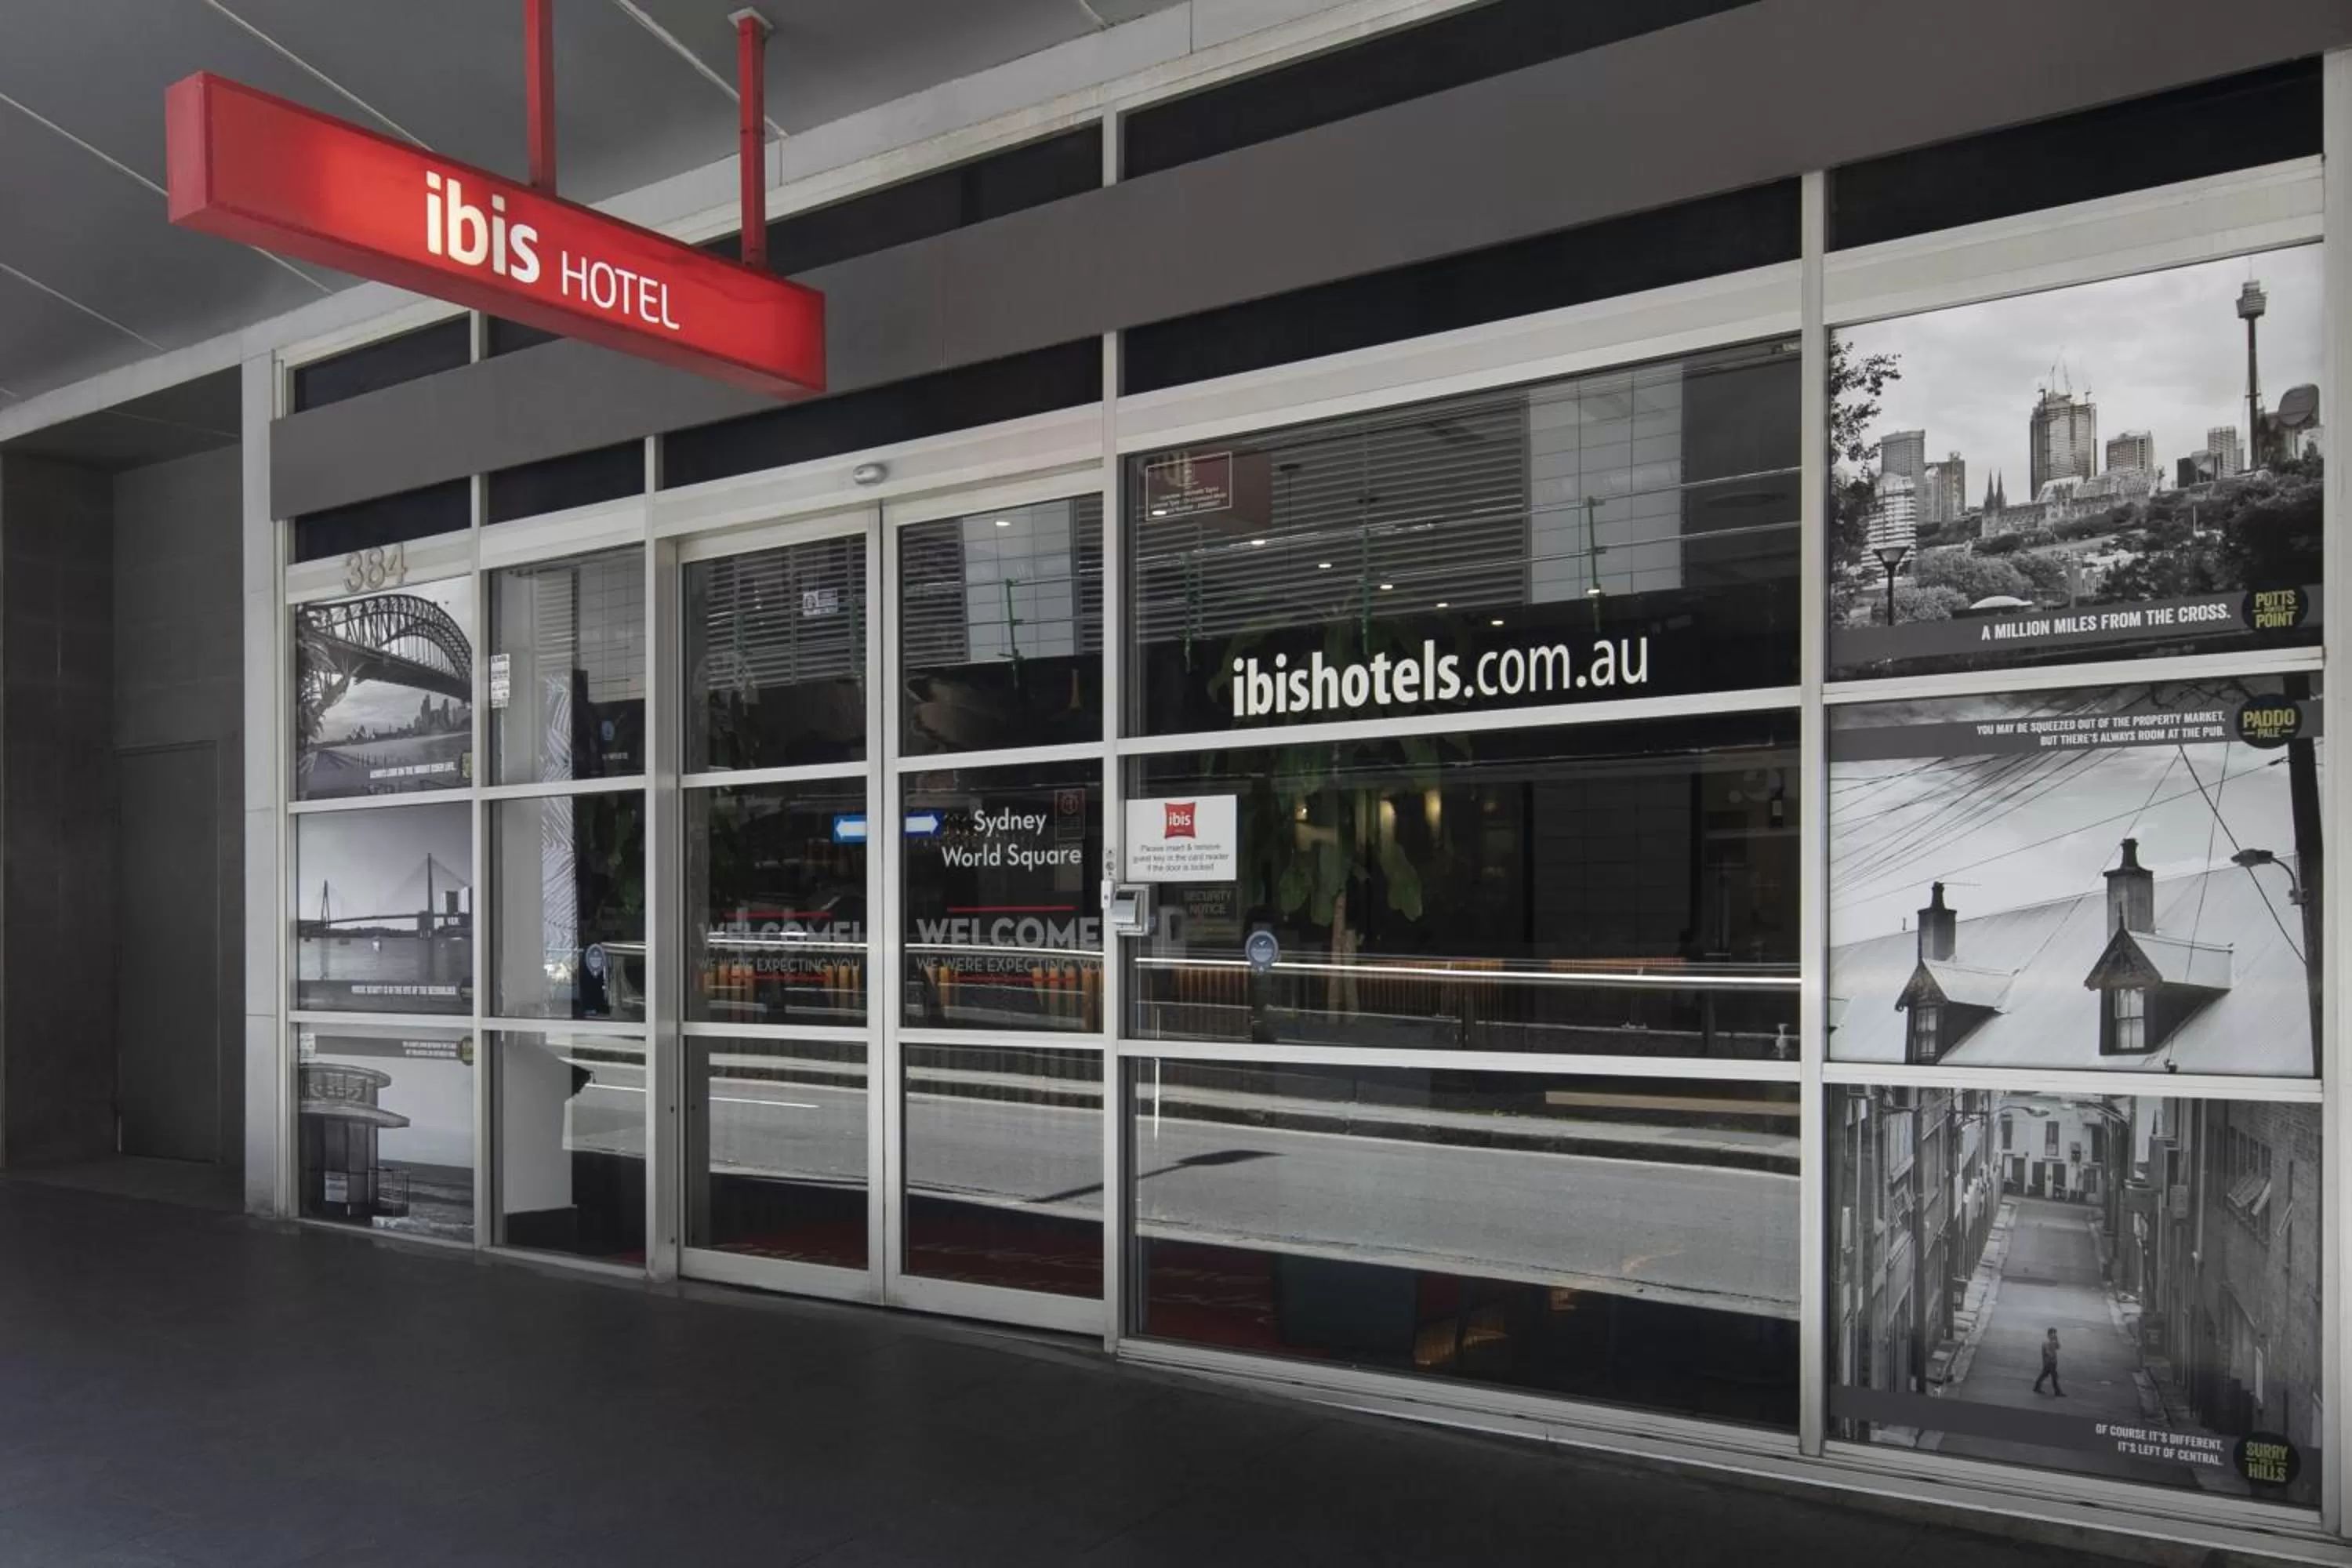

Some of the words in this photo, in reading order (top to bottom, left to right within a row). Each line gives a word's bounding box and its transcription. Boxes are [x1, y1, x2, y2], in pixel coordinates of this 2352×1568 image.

[426, 170, 540, 283] ibis
[561, 251, 680, 329] HOTEL
[343, 542, 408, 592] 384
[2256, 590, 2296, 608] POTTS
[1981, 626, 1991, 641] A
[1994, 619, 2050, 640] MILLION
[2053, 617, 2096, 634] MILES
[2101, 612, 2141, 629] FROM
[2146, 608, 2172, 626] THE
[2178, 604, 2231, 622] CROSS.
[2256, 611, 2296, 629] POINT
[1233, 637, 1648, 717] ibishotels.com.au
[1976, 724, 1994, 735] YOU
[1996, 723, 2015, 734] MAY
[2016, 723, 2028, 733] BE
[2031, 720, 2076, 733] SQUEEZED
[2078, 718, 2096, 729] OUT
[2098, 717, 2109, 728] OF
[2114, 717, 2130, 728] THE
[2132, 713, 2182, 726] PROPERTY
[2183, 710, 2226, 724] MARKET.
[2243, 708, 2296, 728] PADDO
[2040, 735, 2058, 746] BUT
[2060, 733, 2099, 746] THERE'S
[2100, 731, 2136, 742] ALWAYS
[2138, 728, 2165, 740] ROOM
[2167, 728, 2180, 739] AT
[2182, 727, 2201, 738] THE
[2202, 726, 2226, 737] PUB.
[2257, 727, 2281, 738] PALE
[973, 807, 1047, 837] Sydney
[1169, 812, 1191, 826] ibis
[942, 843, 1001, 868] World
[1007, 844, 1082, 872] Square
[756, 956, 827, 973] EXPECTING
[916, 956, 939, 971] WE
[942, 956, 982, 972] WERE
[987, 956, 1073, 975] EXPECTING
[2096, 1423, 2107, 1434] OF
[2110, 1425, 2147, 1440] COURSE
[2149, 1428, 2168, 1443] IT'S
[2169, 1432, 2223, 1450] DIFFERENT.
[2118, 1440, 2136, 1454] IT'S
[2138, 1443, 2161, 1457] LEFT
[2163, 1447, 2174, 1459] OF
[2177, 1449, 2224, 1465] CENTRAL.
[2246, 1441, 2288, 1461] SURRY
[2248, 1463, 2287, 1482] HILLS
